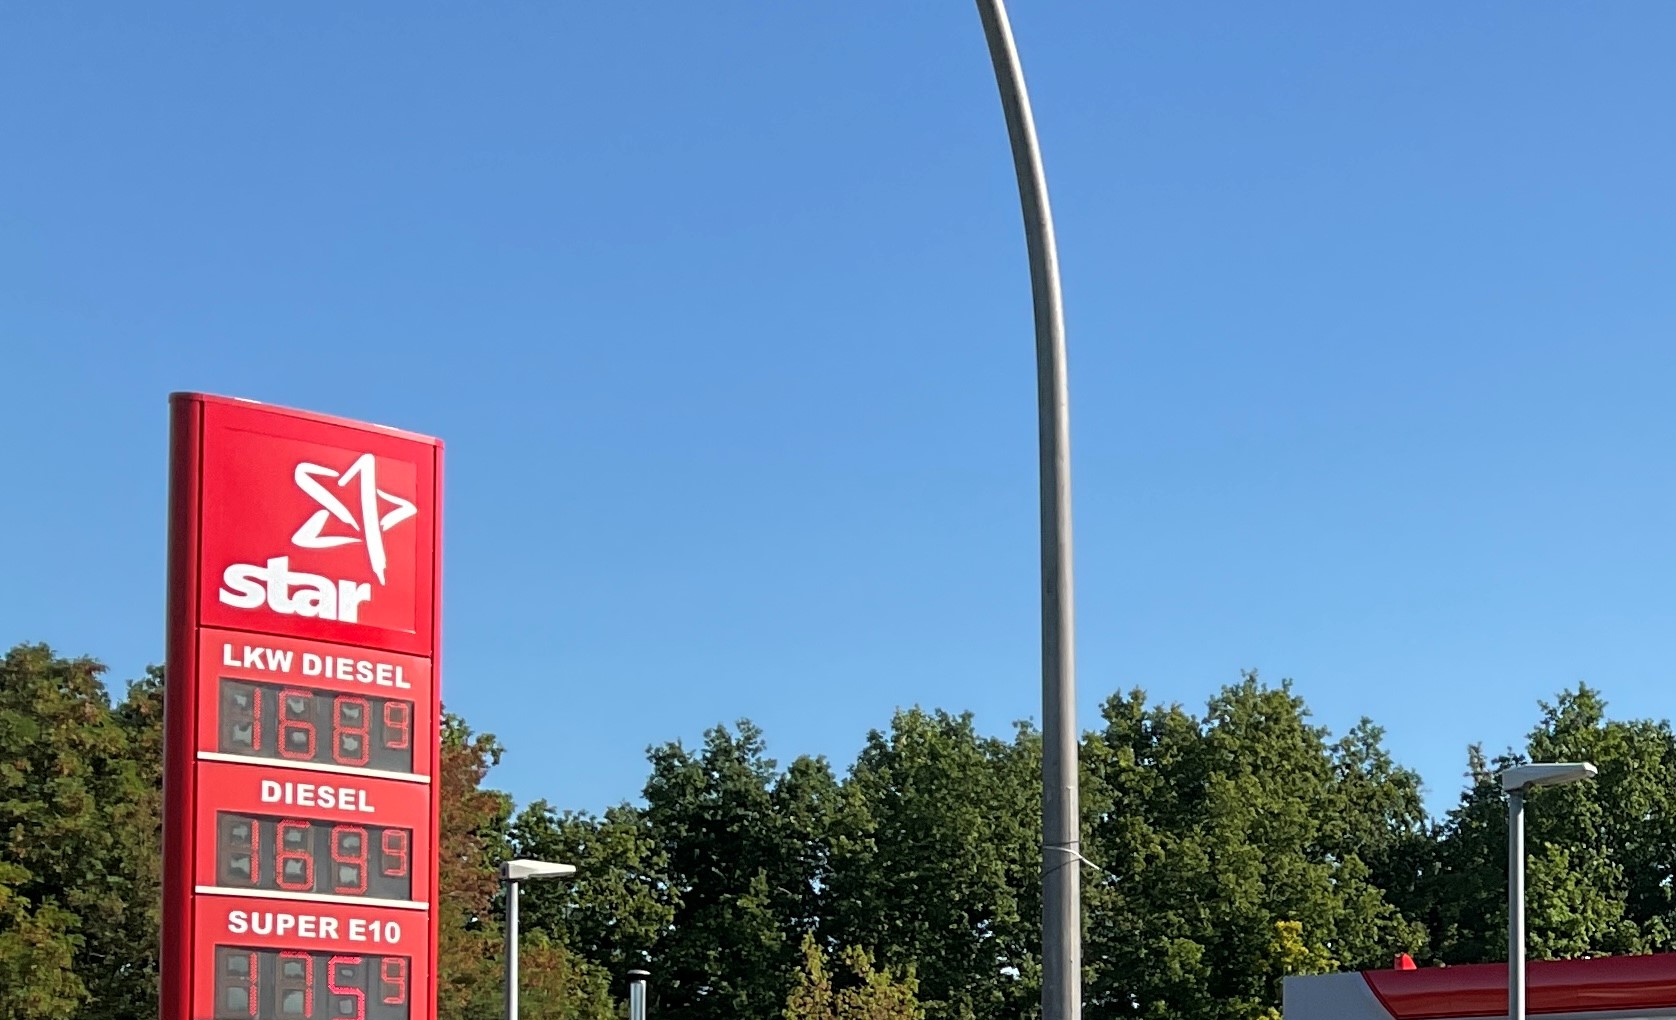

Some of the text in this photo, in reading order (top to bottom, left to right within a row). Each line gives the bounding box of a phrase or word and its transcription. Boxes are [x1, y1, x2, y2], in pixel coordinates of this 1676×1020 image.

[219, 556, 371, 624] star
[222, 642, 412, 689] LKW DIESEL
[260, 779, 375, 813] DIESEL
[227, 910, 402, 944] SUPER E10
